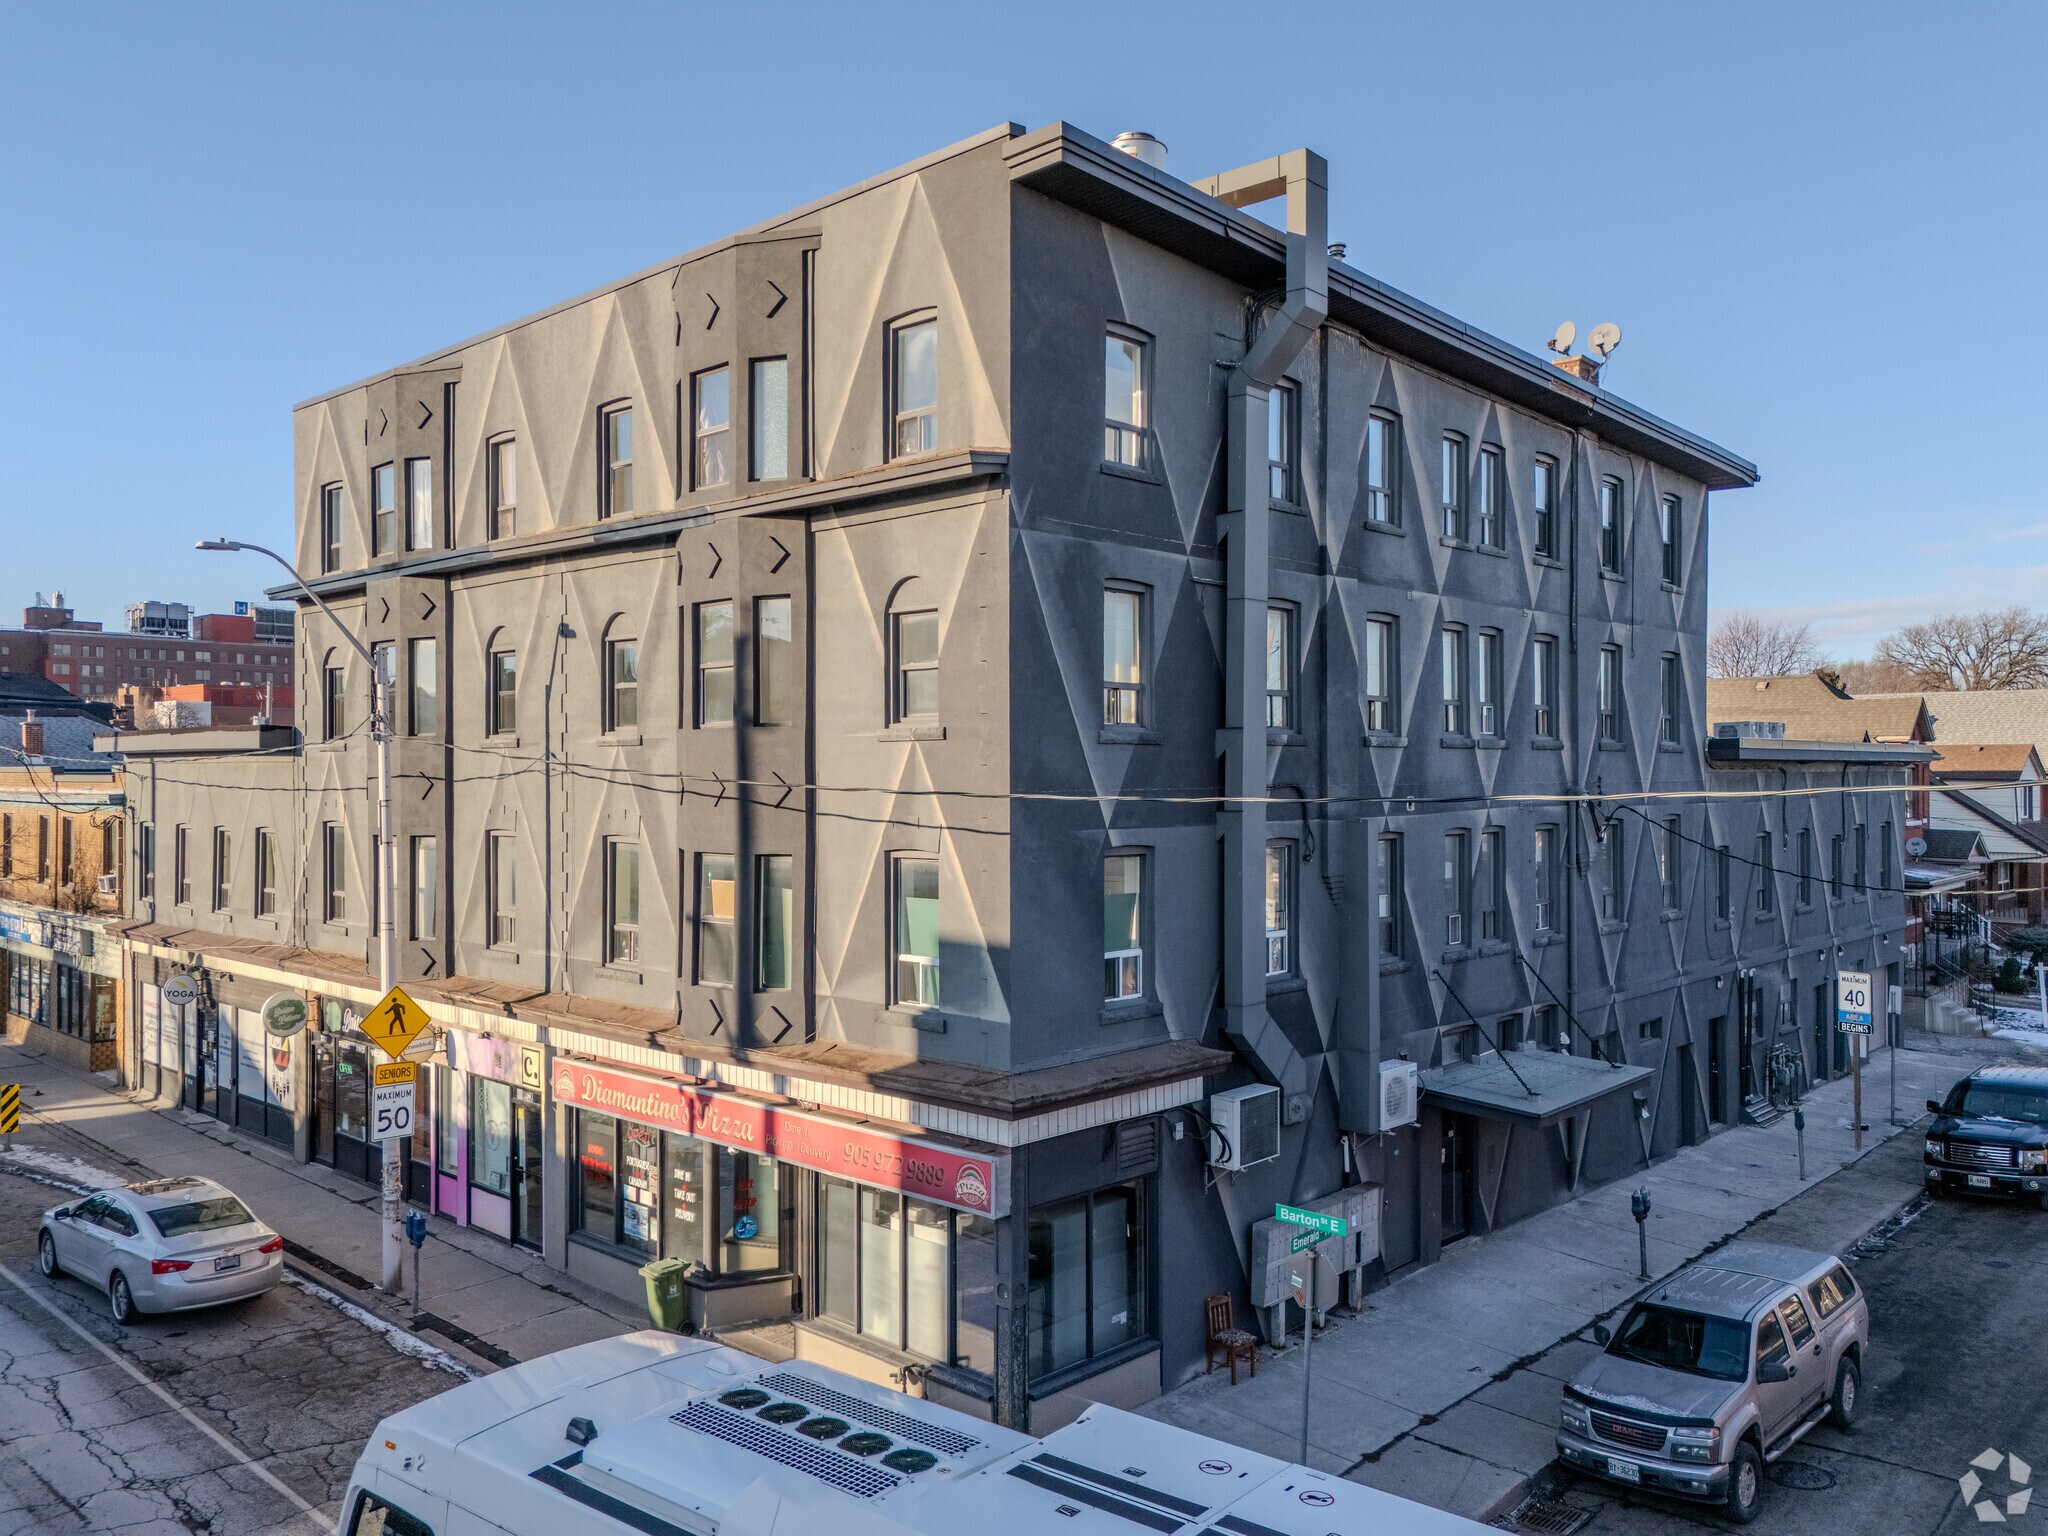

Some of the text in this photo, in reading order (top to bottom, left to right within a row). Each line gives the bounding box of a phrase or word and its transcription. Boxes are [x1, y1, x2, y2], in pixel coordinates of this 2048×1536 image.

[1841, 976, 1867, 985] MAXIMUM
[166, 990, 195, 998] YOGA
[1844, 989, 1865, 1007] 40
[1845, 1013, 1864, 1021] AREA
[1841, 1022, 1869, 1034] BEGINS
[406, 1039, 433, 1051] rumbled.
[339, 1063, 353, 1075] OPEN
[379, 1066, 412, 1080] SENIORS
[376, 1089, 412, 1101] MAXIMUM
[581, 1074, 755, 1142] Diamantino's Pizza
[377, 1106, 410, 1133] 50
[765, 1133, 781, 1149] Pick
[800, 1142, 831, 1163] Delivery
[843, 1143, 945, 1188] 905 972 9889
[957, 1182, 986, 1198] Pizza
[1280, 1207, 1320, 1228] Barton
[1330, 1219, 1339, 1232] E
[1293, 1230, 1320, 1251] Emerald
[417, 1453, 426, 1473] 2
